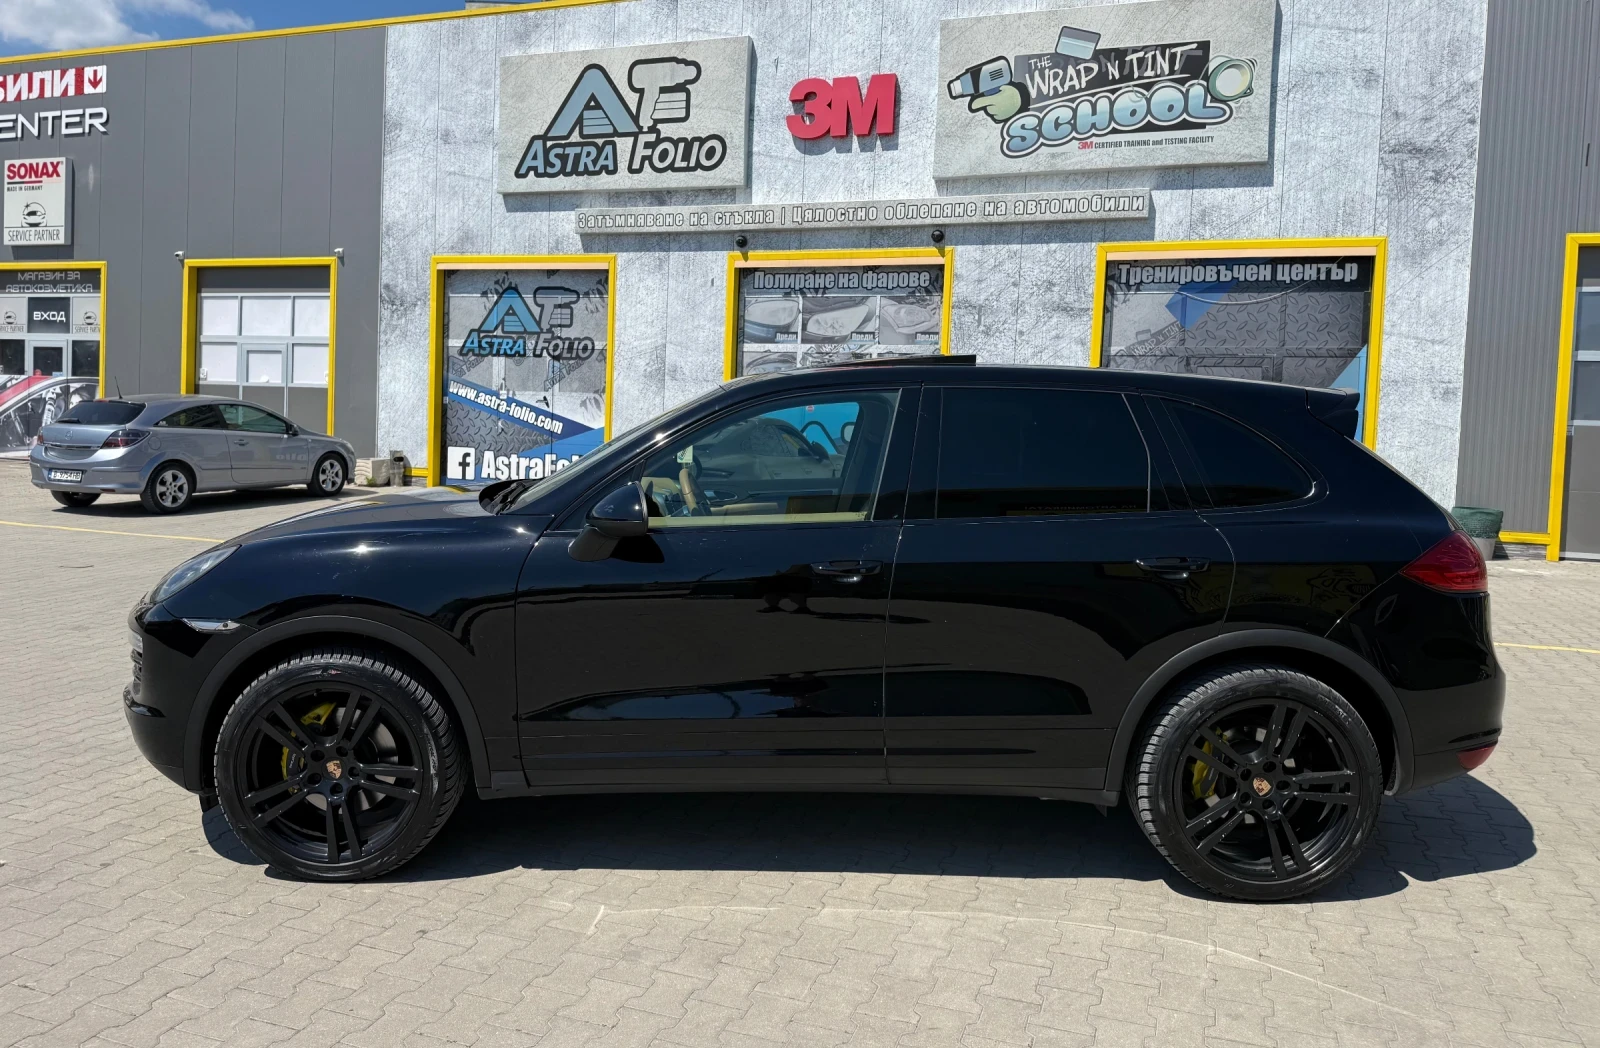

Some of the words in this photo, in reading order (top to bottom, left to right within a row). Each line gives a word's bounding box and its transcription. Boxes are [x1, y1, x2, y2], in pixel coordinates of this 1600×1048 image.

[1025, 62, 1098, 99] WRAP
[1108, 59, 1120, 79] N
[1124, 43, 1198, 79] TINT
[1029, 56, 1052, 70] THE
[0, 68, 75, 102] ИЛИ
[786, 74, 897, 140] 3M
[1003, 82, 1230, 154] SCHOOL
[0, 107, 107, 138] ENTER
[517, 138, 616, 176] ASTRA
[631, 133, 724, 171] FOLIO
[1078, 141, 1093, 150] 3M
[1094, 140, 1122, 149] CERTIFIED
[1123, 139, 1151, 148] TRAINING
[1151, 138, 1163, 146] and
[1164, 137, 1188, 145] TESTING
[1188, 135, 1214, 144] FACILITY
[7, 161, 61, 180] SONAX
[578, 212, 684, 228] Затъмняване
[689, 212, 708, 227] на
[714, 209, 775, 225] стъкла
[792, 206, 878, 225] Цялостно
[884, 201, 977, 220] облепяне
[984, 201, 1007, 216] на
[1014, 194, 1145, 216] автомобили
[8, 229, 32, 242] SERVICE
[34, 229, 60, 242] PARTNER
[17, 271, 65, 281] МАГАЗИН
[67, 271, 80, 280] ЗА
[754, 270, 835, 291] Полиране
[838, 271, 860, 289] на
[861, 270, 930, 291] фарове
[1118, 263, 1275, 286] Тренировъчен
[1276, 261, 1358, 285] център
[6, 283, 93, 293] АВТОКОЗМЕТИКА
[33, 311, 66, 323] ВХОД
[461, 331, 525, 355] ASTRA
[535, 333, 593, 358] FOLIO
[449, 380, 564, 435] www.astra-folio.com
[480, 450, 580, 481] AstraFo
